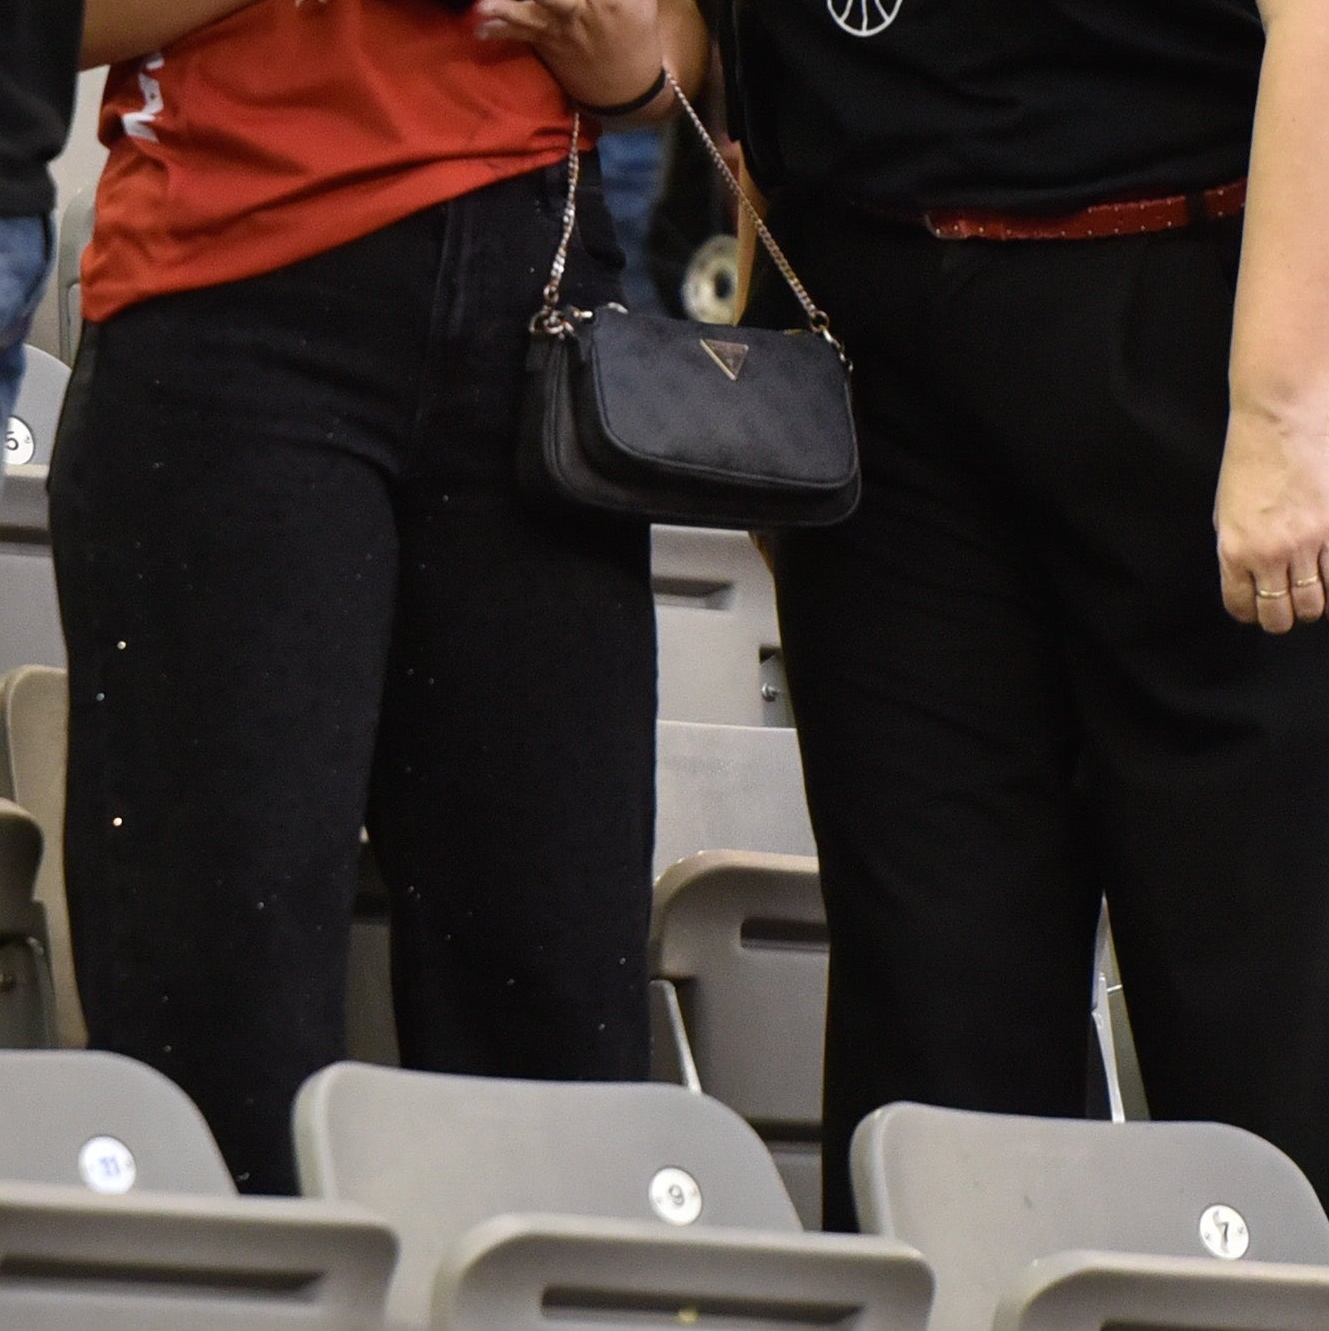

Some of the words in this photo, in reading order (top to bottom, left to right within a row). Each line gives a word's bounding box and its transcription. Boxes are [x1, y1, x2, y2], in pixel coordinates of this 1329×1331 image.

[5, 430, 19, 451] 5
[667, 1183, 686, 1207] 9
[1215, 1221, 1230, 1245] 7
